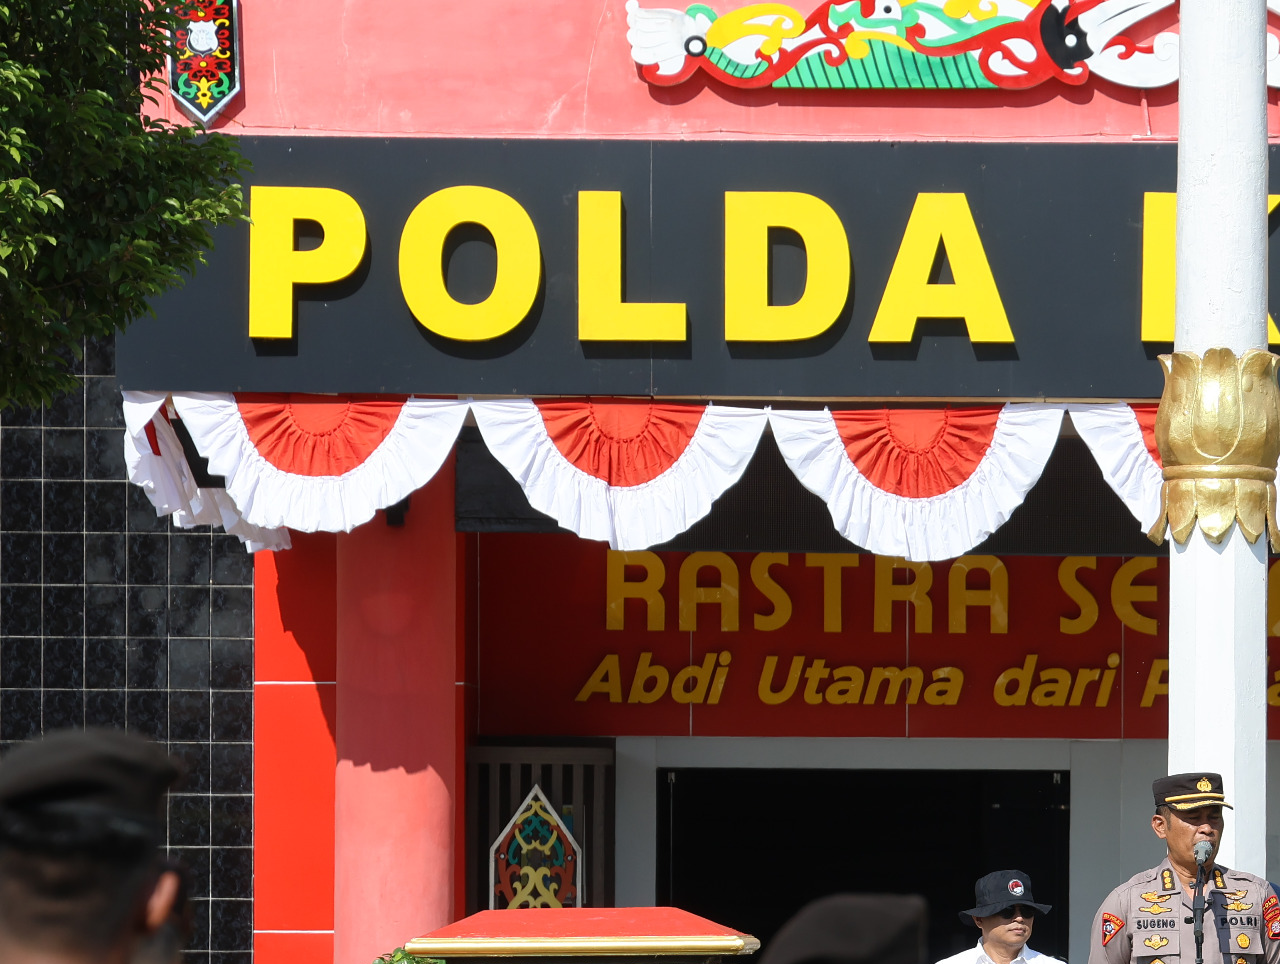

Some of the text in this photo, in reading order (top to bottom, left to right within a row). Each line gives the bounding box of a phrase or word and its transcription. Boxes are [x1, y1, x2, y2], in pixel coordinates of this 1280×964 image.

[249, 185, 1016, 345] POLDA
[606, 550, 1009, 634] RASTRA
[574, 650, 732, 705] Abdi
[757, 654, 964, 706] Utama
[993, 652, 1120, 707] dari
[1136, 918, 1176, 930] SUGENG
[1220, 916, 1258, 927] POLRI
